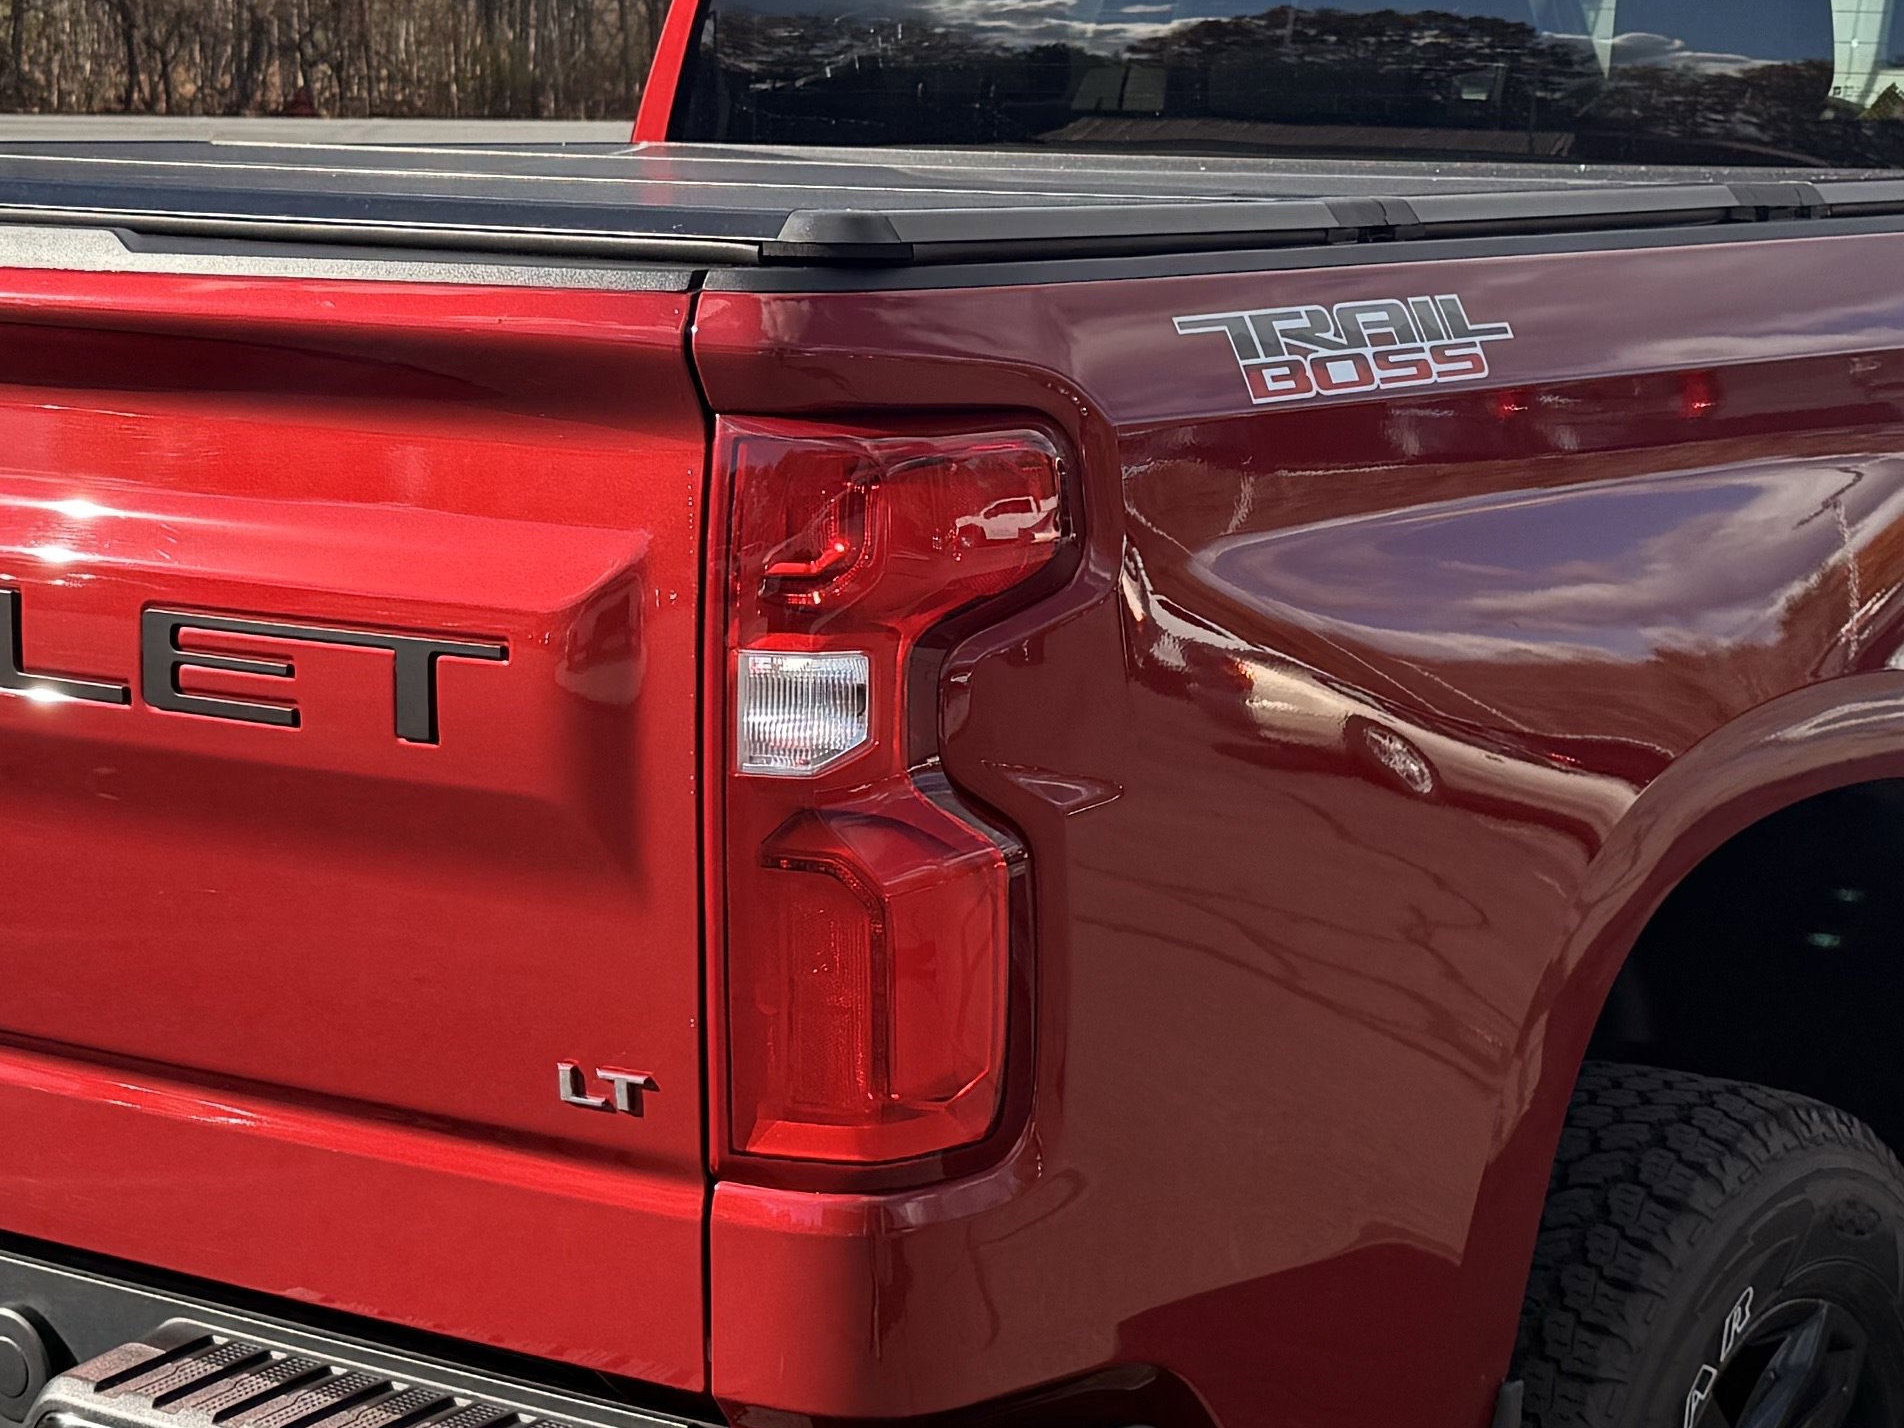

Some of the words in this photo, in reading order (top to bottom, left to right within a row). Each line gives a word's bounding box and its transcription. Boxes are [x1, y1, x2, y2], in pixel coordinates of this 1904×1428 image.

[1172, 294, 1514, 361] TRAIL
[1241, 341, 1489, 404] BOSS
[556, 1060, 654, 1113] LT
